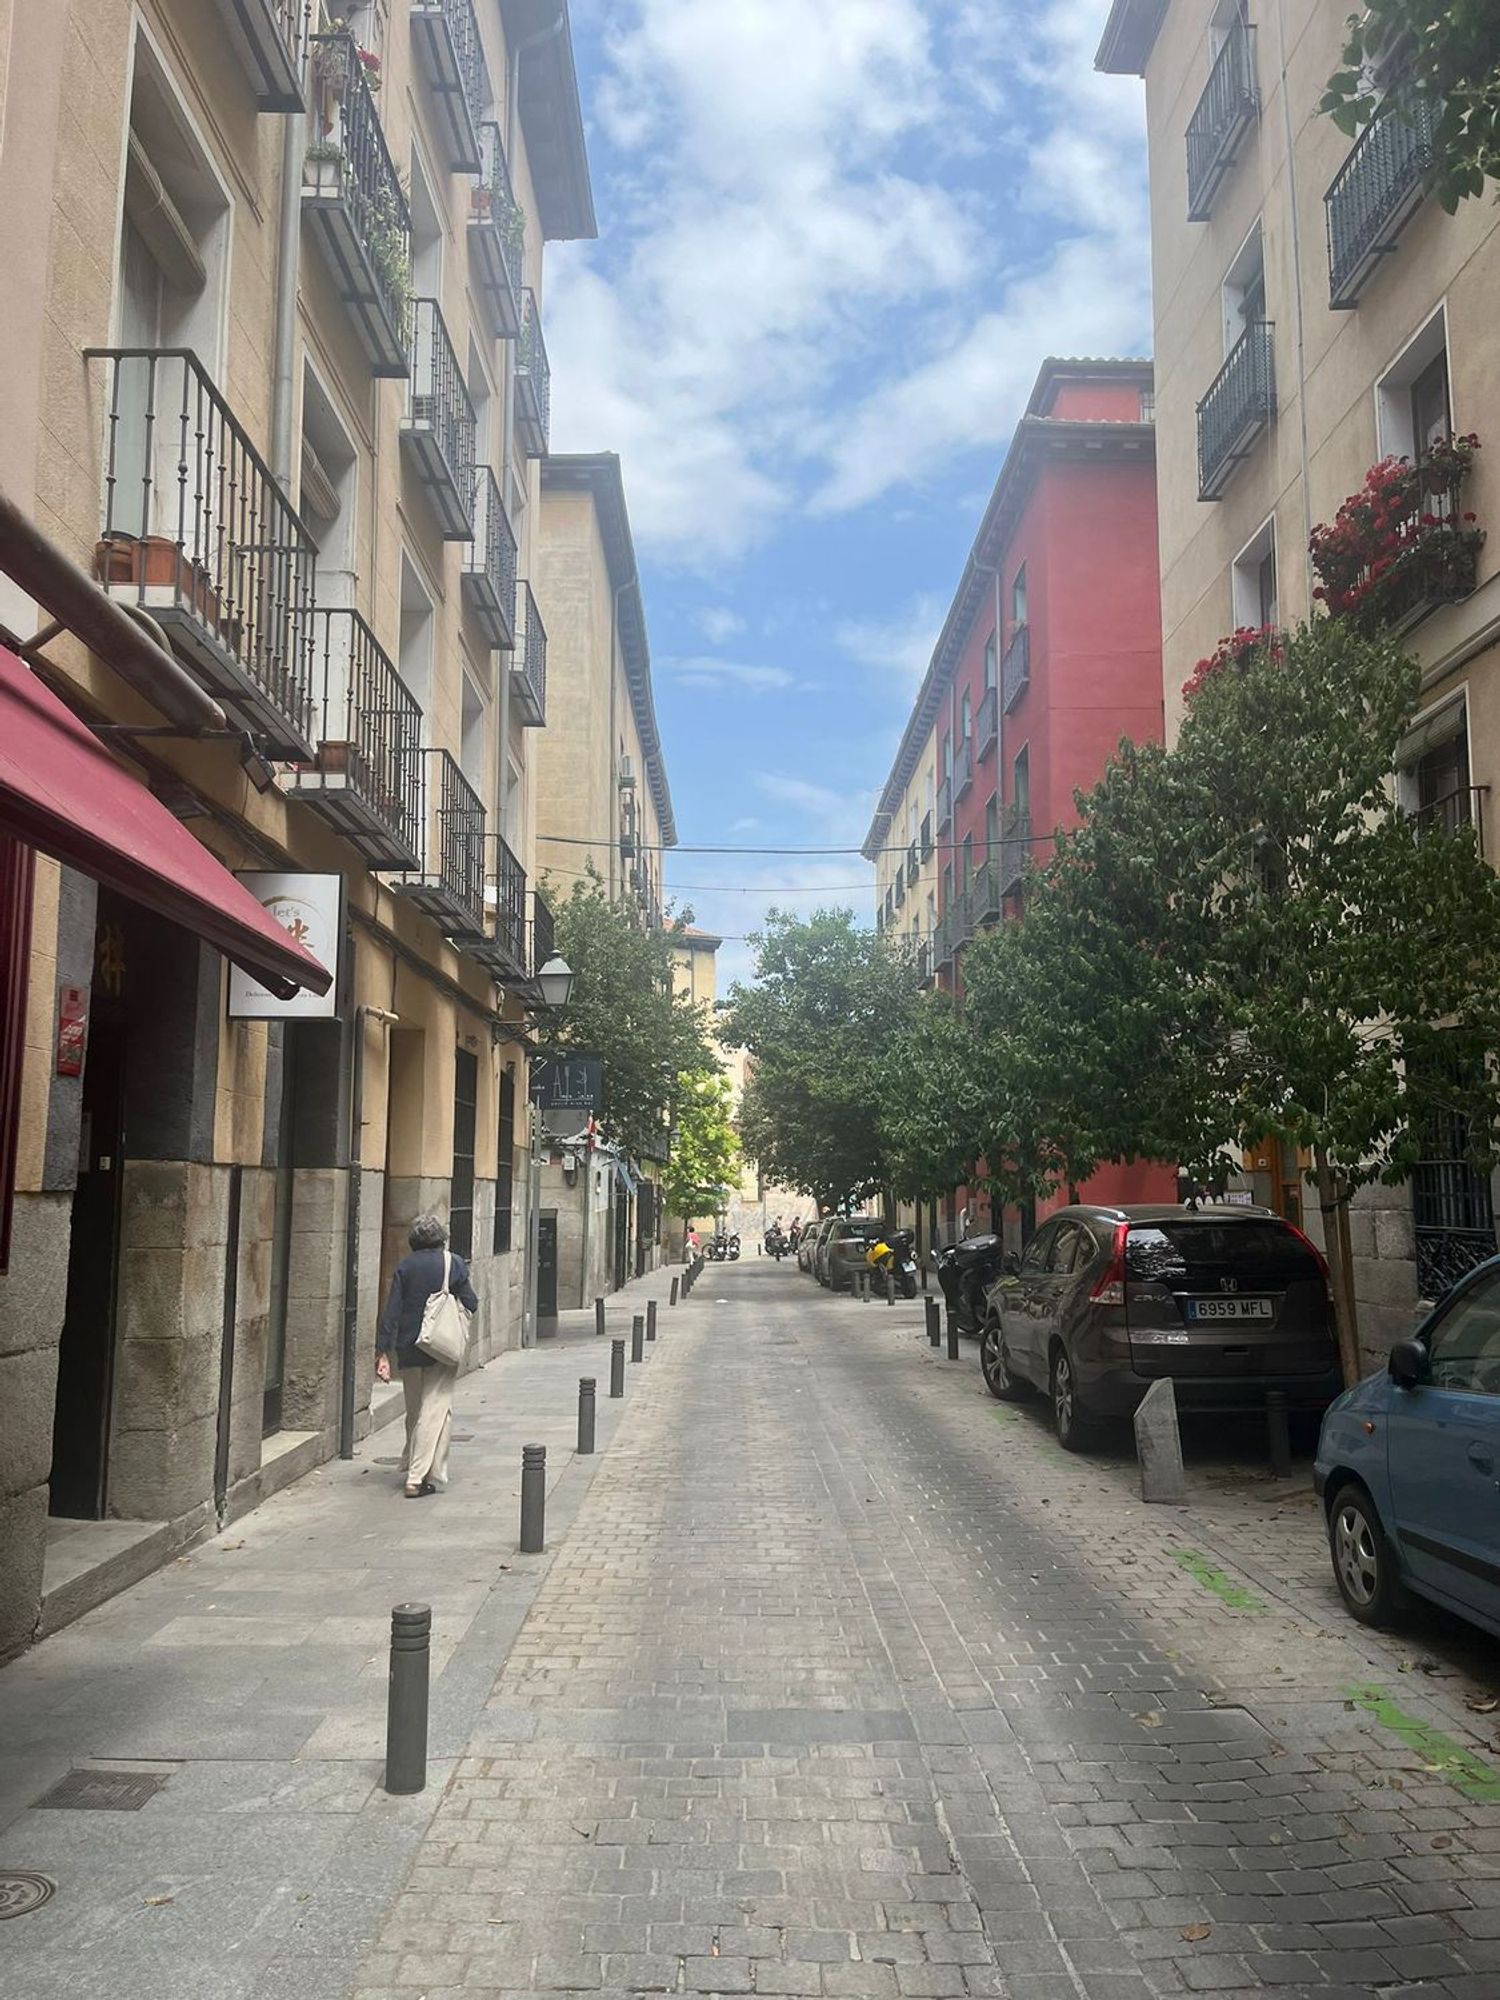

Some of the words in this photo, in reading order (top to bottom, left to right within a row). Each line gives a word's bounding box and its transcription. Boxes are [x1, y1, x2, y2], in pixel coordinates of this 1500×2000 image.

[273, 904, 300, 918] let's
[1199, 1302, 1236, 1316] 6959
[1241, 1301, 1269, 1316] MFL
